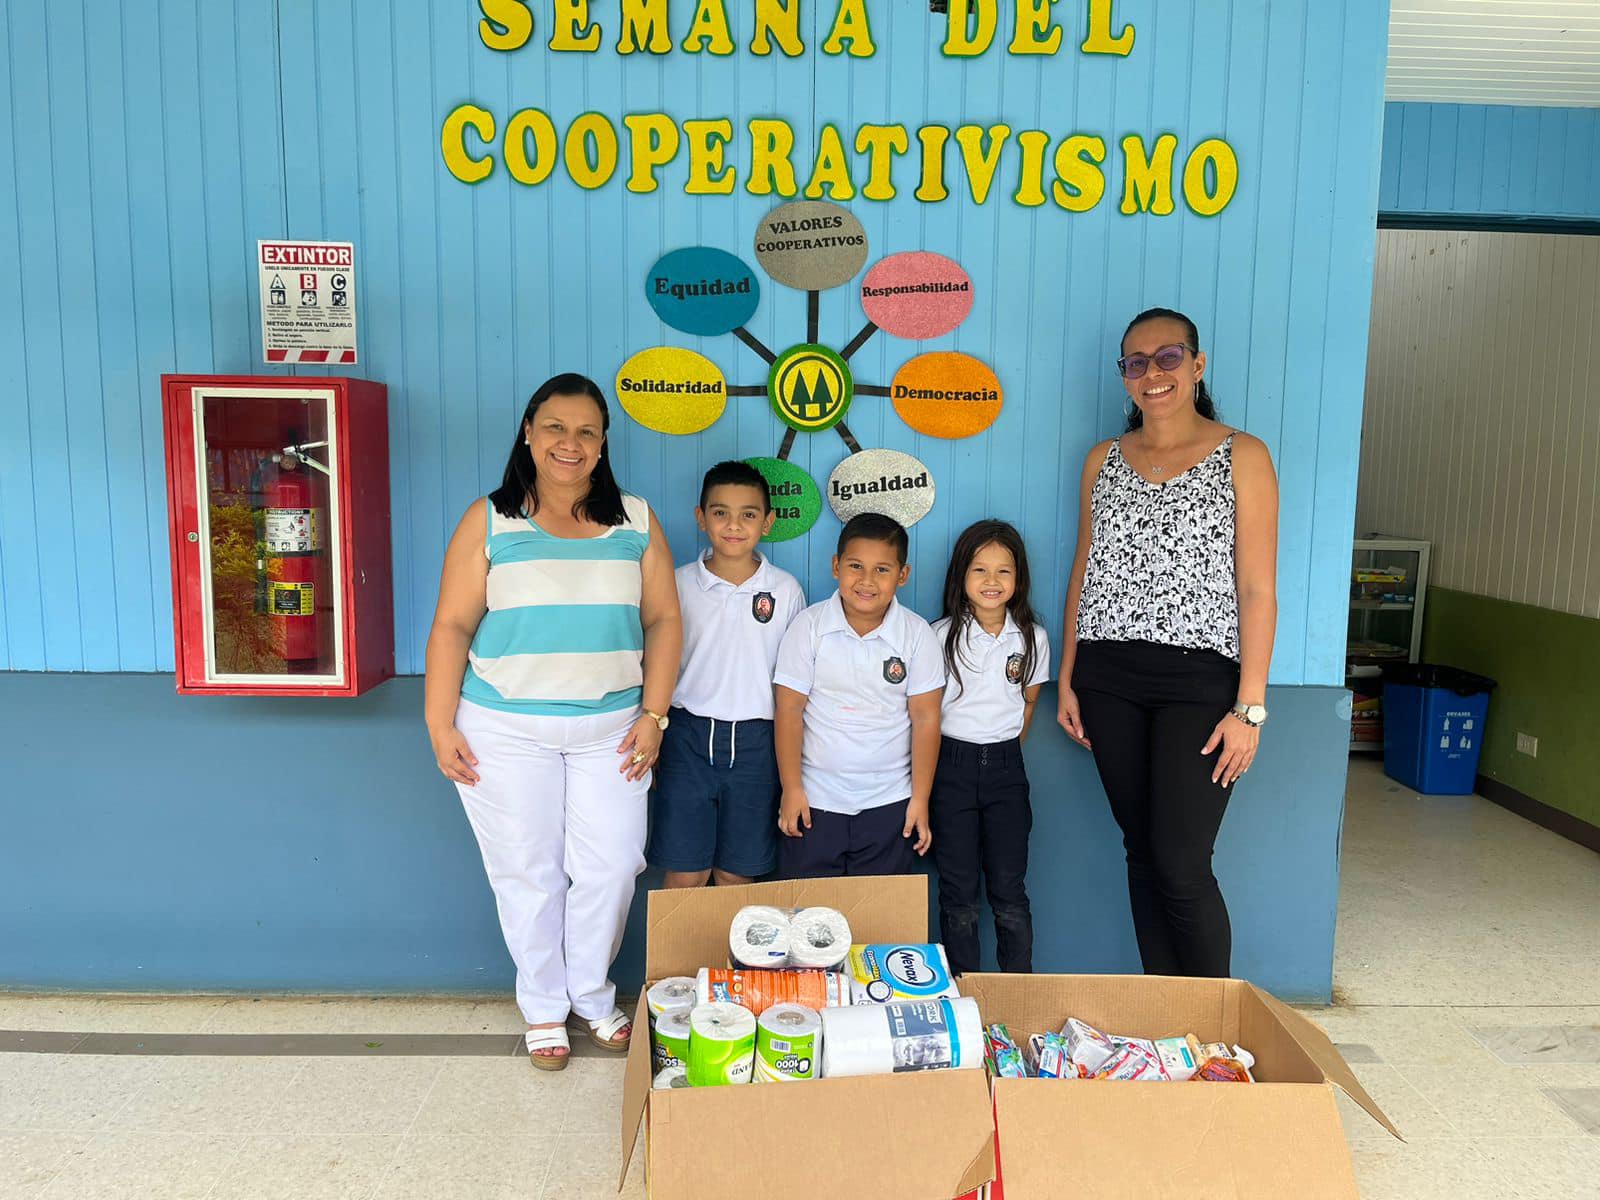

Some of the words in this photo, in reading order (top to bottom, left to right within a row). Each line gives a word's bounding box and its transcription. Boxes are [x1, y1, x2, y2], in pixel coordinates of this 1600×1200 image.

[478, 0, 876, 57] SEMANA
[942, 0, 1136, 58] DEL
[440, 104, 1240, 217] COOPERATIVISMO
[768, 216, 843, 235] VALORES
[756, 235, 864, 252] COOPERATIVOS
[263, 247, 351, 264] EXTINTOR
[303, 274, 315, 289] B
[331, 274, 346, 289] C
[654, 277, 751, 297] Equidad
[862, 281, 969, 298] Responsabilidad
[620, 377, 722, 395] Solidaridad
[894, 385, 998, 401] Democracia
[769, 480, 802, 496] uda
[832, 472, 928, 500] Igualdad
[899, 951, 918, 982] Nevax
[775, 1059, 798, 1068] 1000
